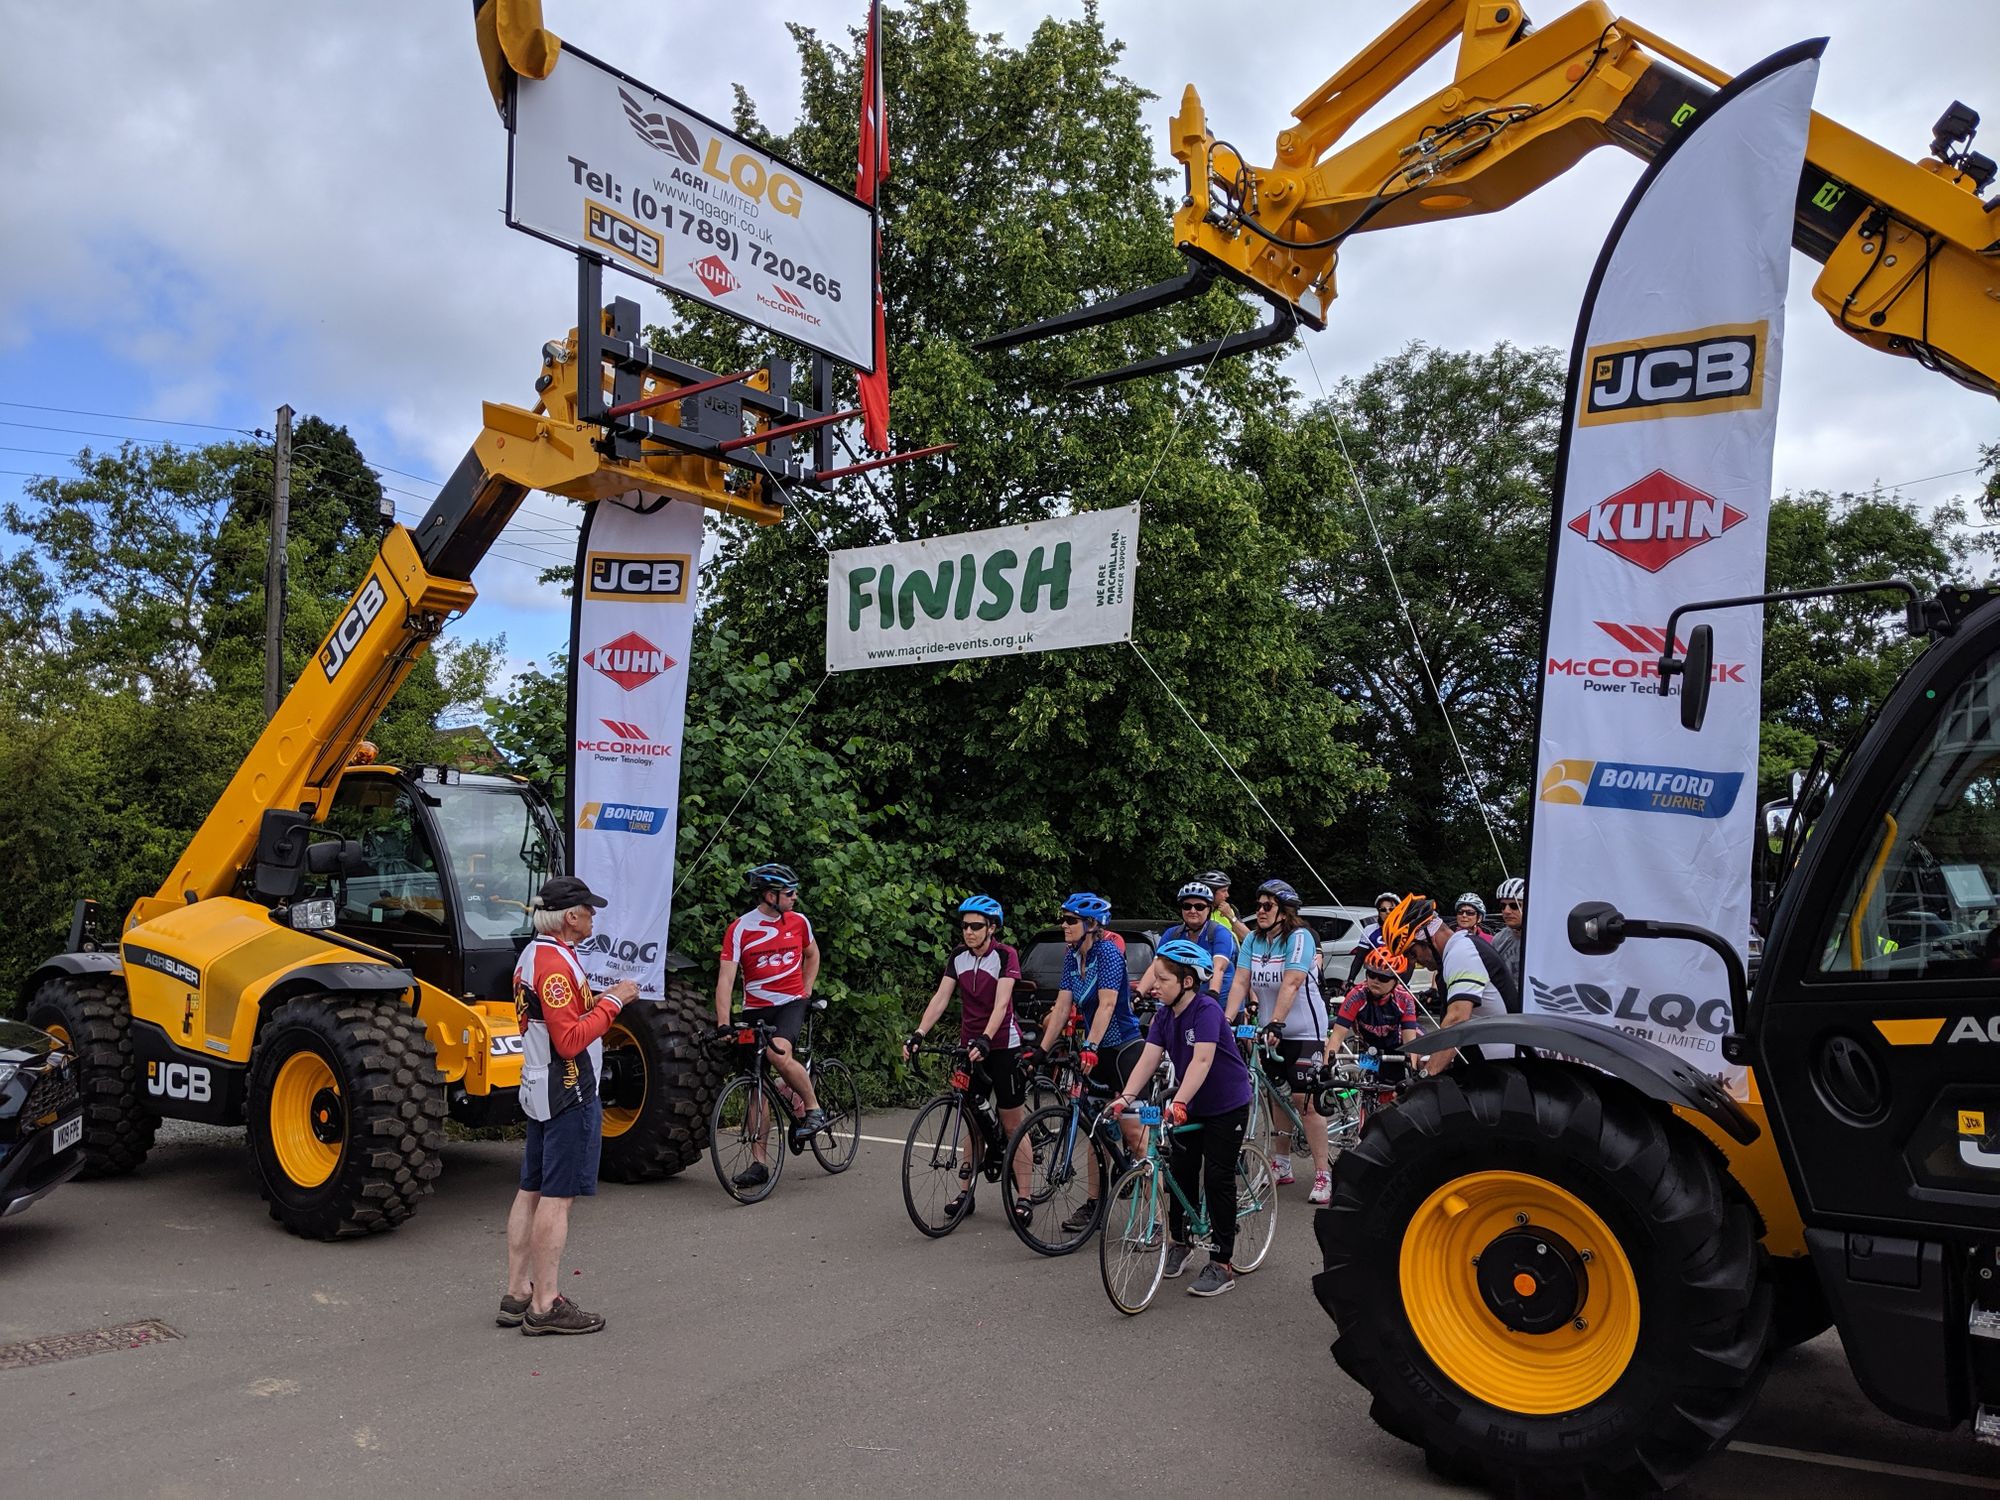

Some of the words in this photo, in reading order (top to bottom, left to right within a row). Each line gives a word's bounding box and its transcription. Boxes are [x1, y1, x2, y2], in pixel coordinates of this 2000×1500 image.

[670, 167, 709, 194] AGRI
[712, 185, 760, 219] LIMITED
[702, 137, 803, 219] LQG
[653, 178, 773, 245] www.lqgagri.co.uk
[567, 155, 622, 204] Tel:
[633, 187, 739, 262] (01789)
[748, 241, 842, 302] 720265
[591, 211, 658, 265] JCB
[691, 258, 738, 290] KUHN
[756, 293, 821, 327] McCORMICK
[1594, 341, 1751, 407] JCB
[1587, 499, 1725, 541] KUHN
[1118, 535, 1127, 570] SUPPORT
[593, 562, 681, 592] JCB
[848, 541, 1072, 632] FINISH
[1097, 563, 1106, 587] ARE
[1096, 588, 1105, 607] WE
[325, 579, 385, 678] JCB
[593, 648, 666, 673] KUHN
[867, 632, 1034, 660] www.macride-events.org.uk
[1547, 658, 1746, 683] McCORK
[1583, 680, 1626, 693] Power
[577, 740, 673, 757] McCORMICK
[594, 753, 618, 762] Power
[1599, 768, 1715, 797] BOMFORD
[1651, 793, 1706, 812] TURNER
[609, 937, 658, 964] LQG
[621, 964, 648, 974] LIMITE
[1614, 986, 1733, 1036] LQG
[490, 1036, 523, 1055] JC
[1658, 1031, 1716, 1053] LIMITED
[147, 1061, 212, 1102] JCB
